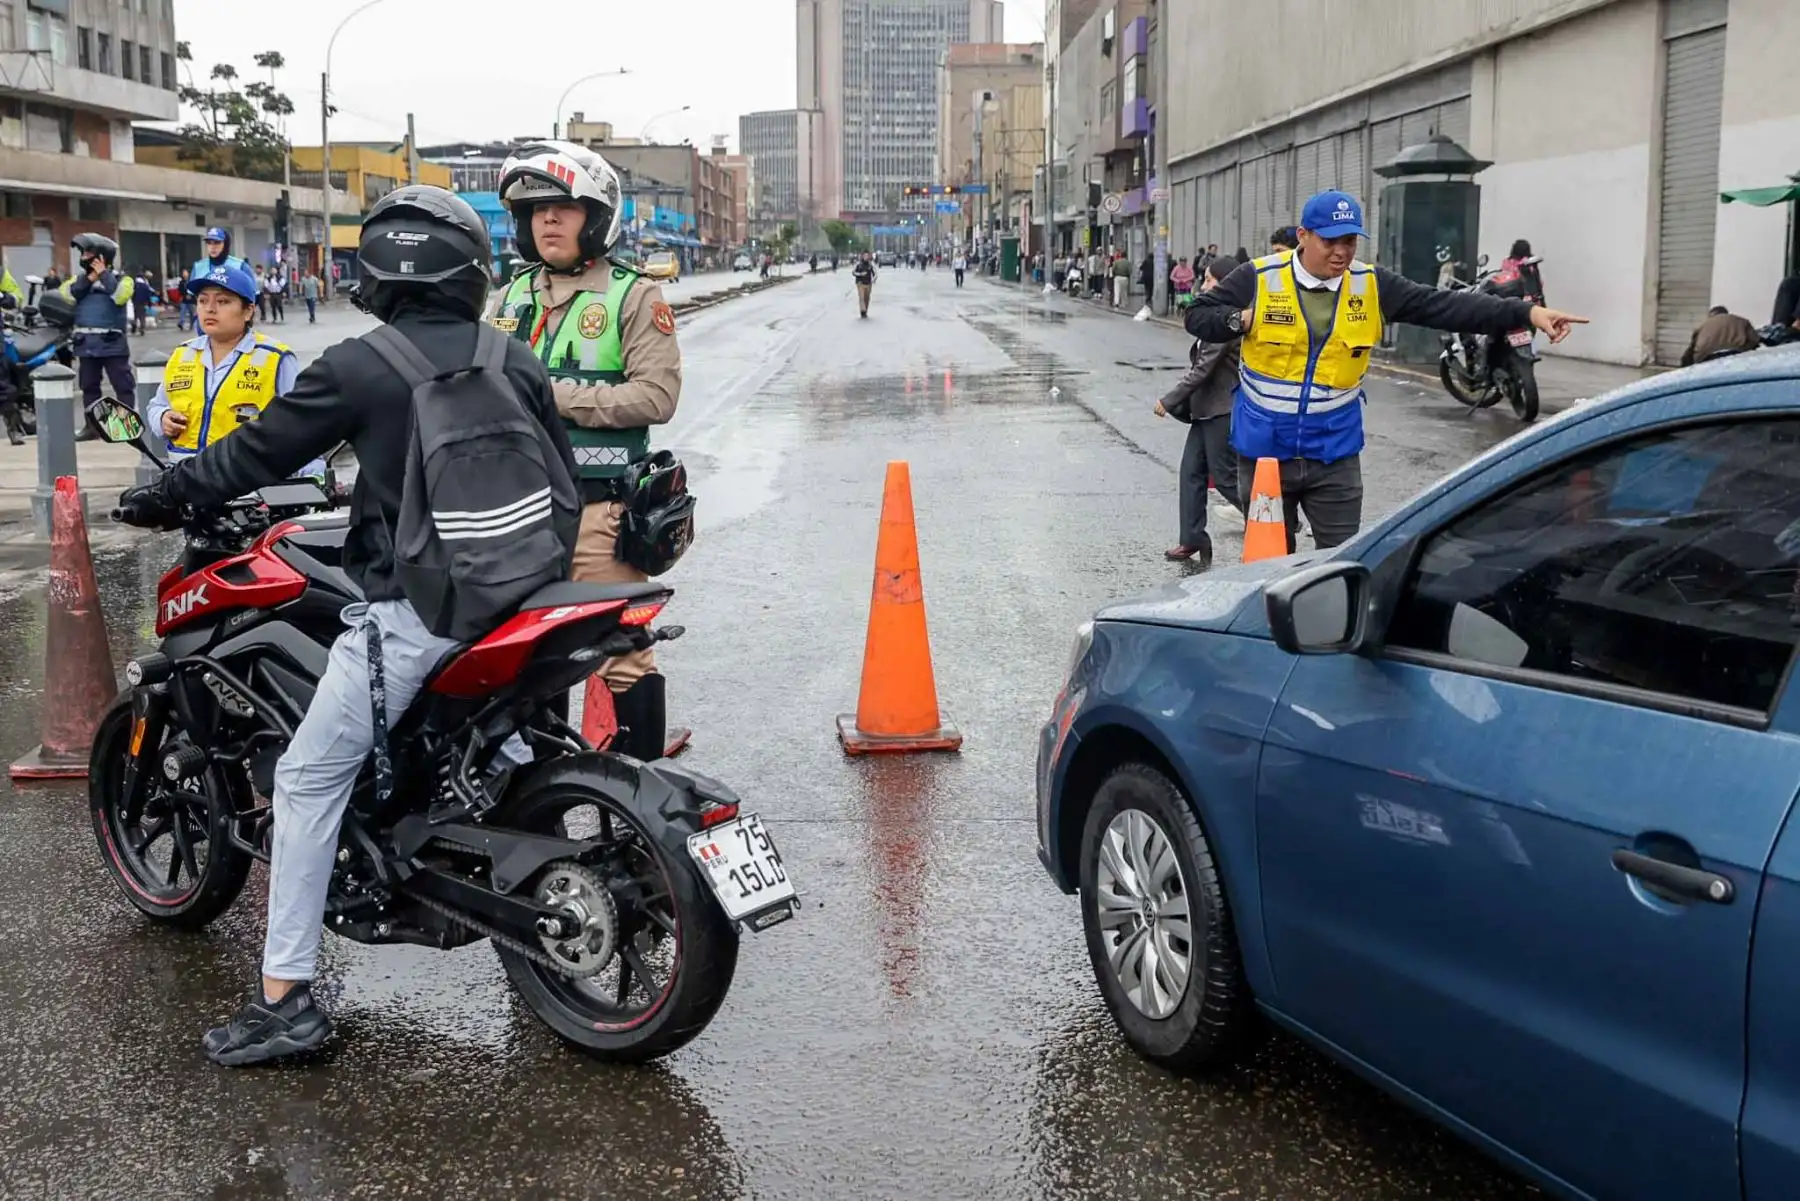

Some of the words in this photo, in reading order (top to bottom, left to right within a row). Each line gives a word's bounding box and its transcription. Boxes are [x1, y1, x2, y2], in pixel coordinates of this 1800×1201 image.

[1333, 211, 1355, 221] LIMA
[1348, 314, 1368, 322] LIMA
[237, 382, 261, 392] LIMA
[735, 823, 769, 857] 75
[705, 855, 729, 870] PERU
[729, 854, 786, 899] 15LD
